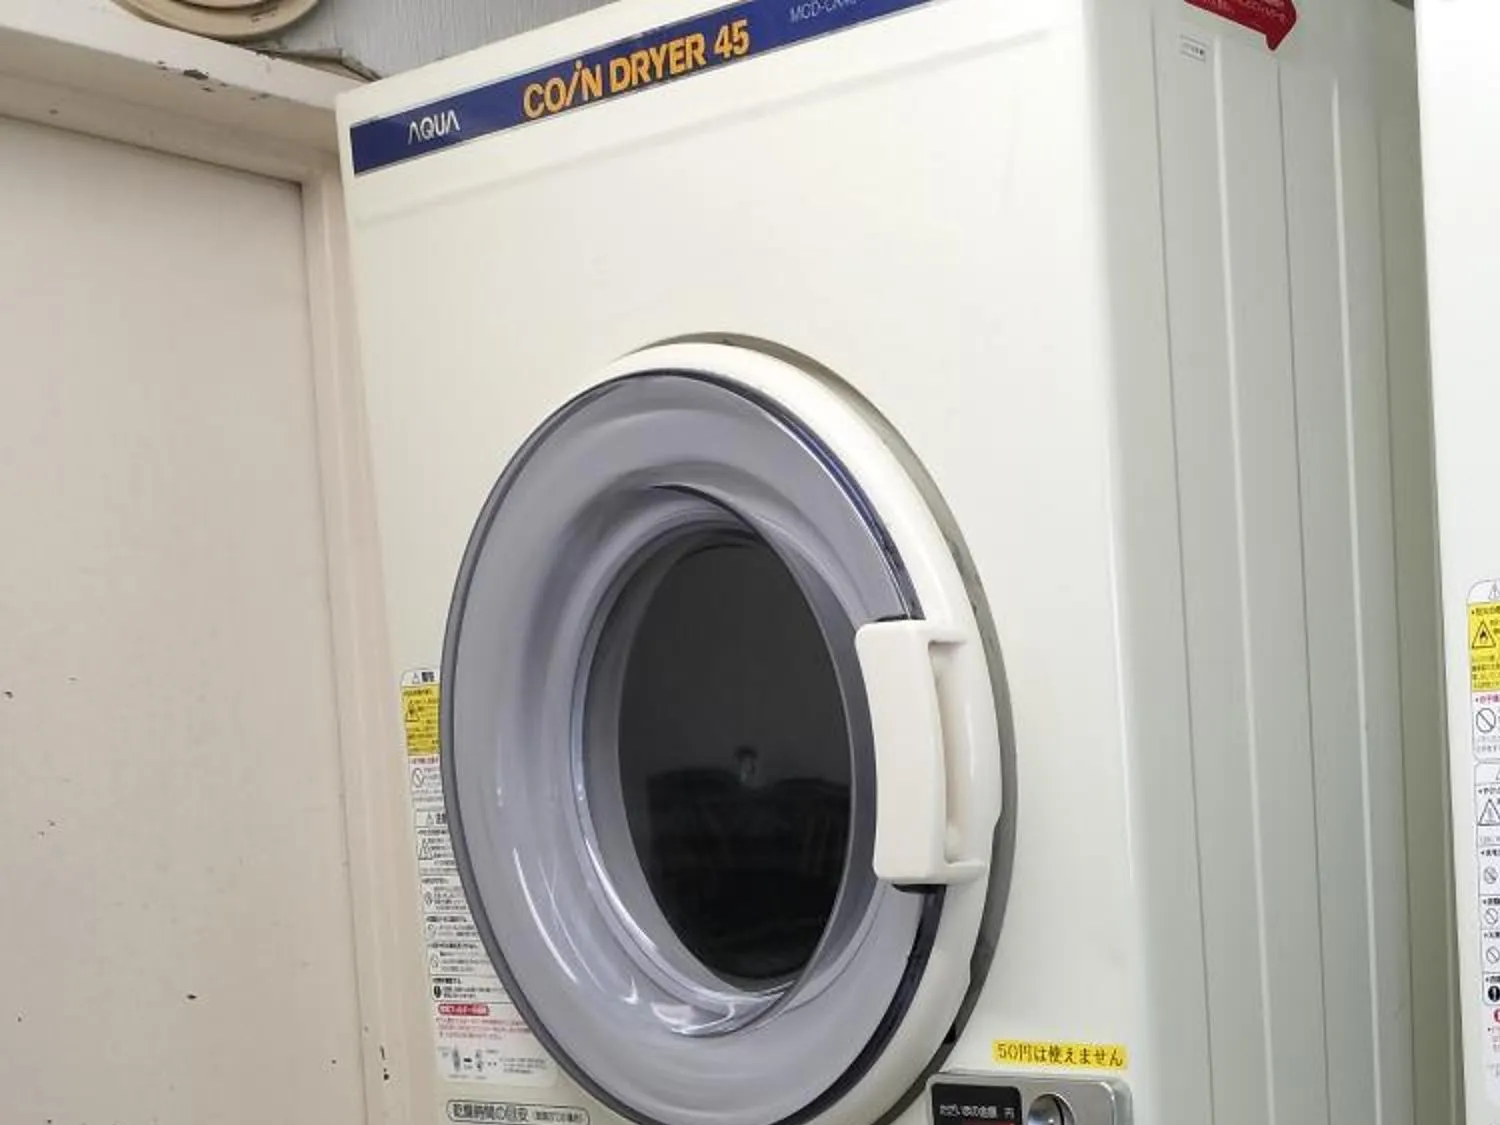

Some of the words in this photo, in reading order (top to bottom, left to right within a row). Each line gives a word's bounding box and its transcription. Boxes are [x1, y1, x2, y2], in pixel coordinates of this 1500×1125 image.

[523, 59, 603, 119] COIN
[609, 32, 706, 93] DRYER
[713, 19, 750, 59] 45
[408, 110, 460, 145] AQUA
[997, 1044, 1123, 1067] 50円は使えません
